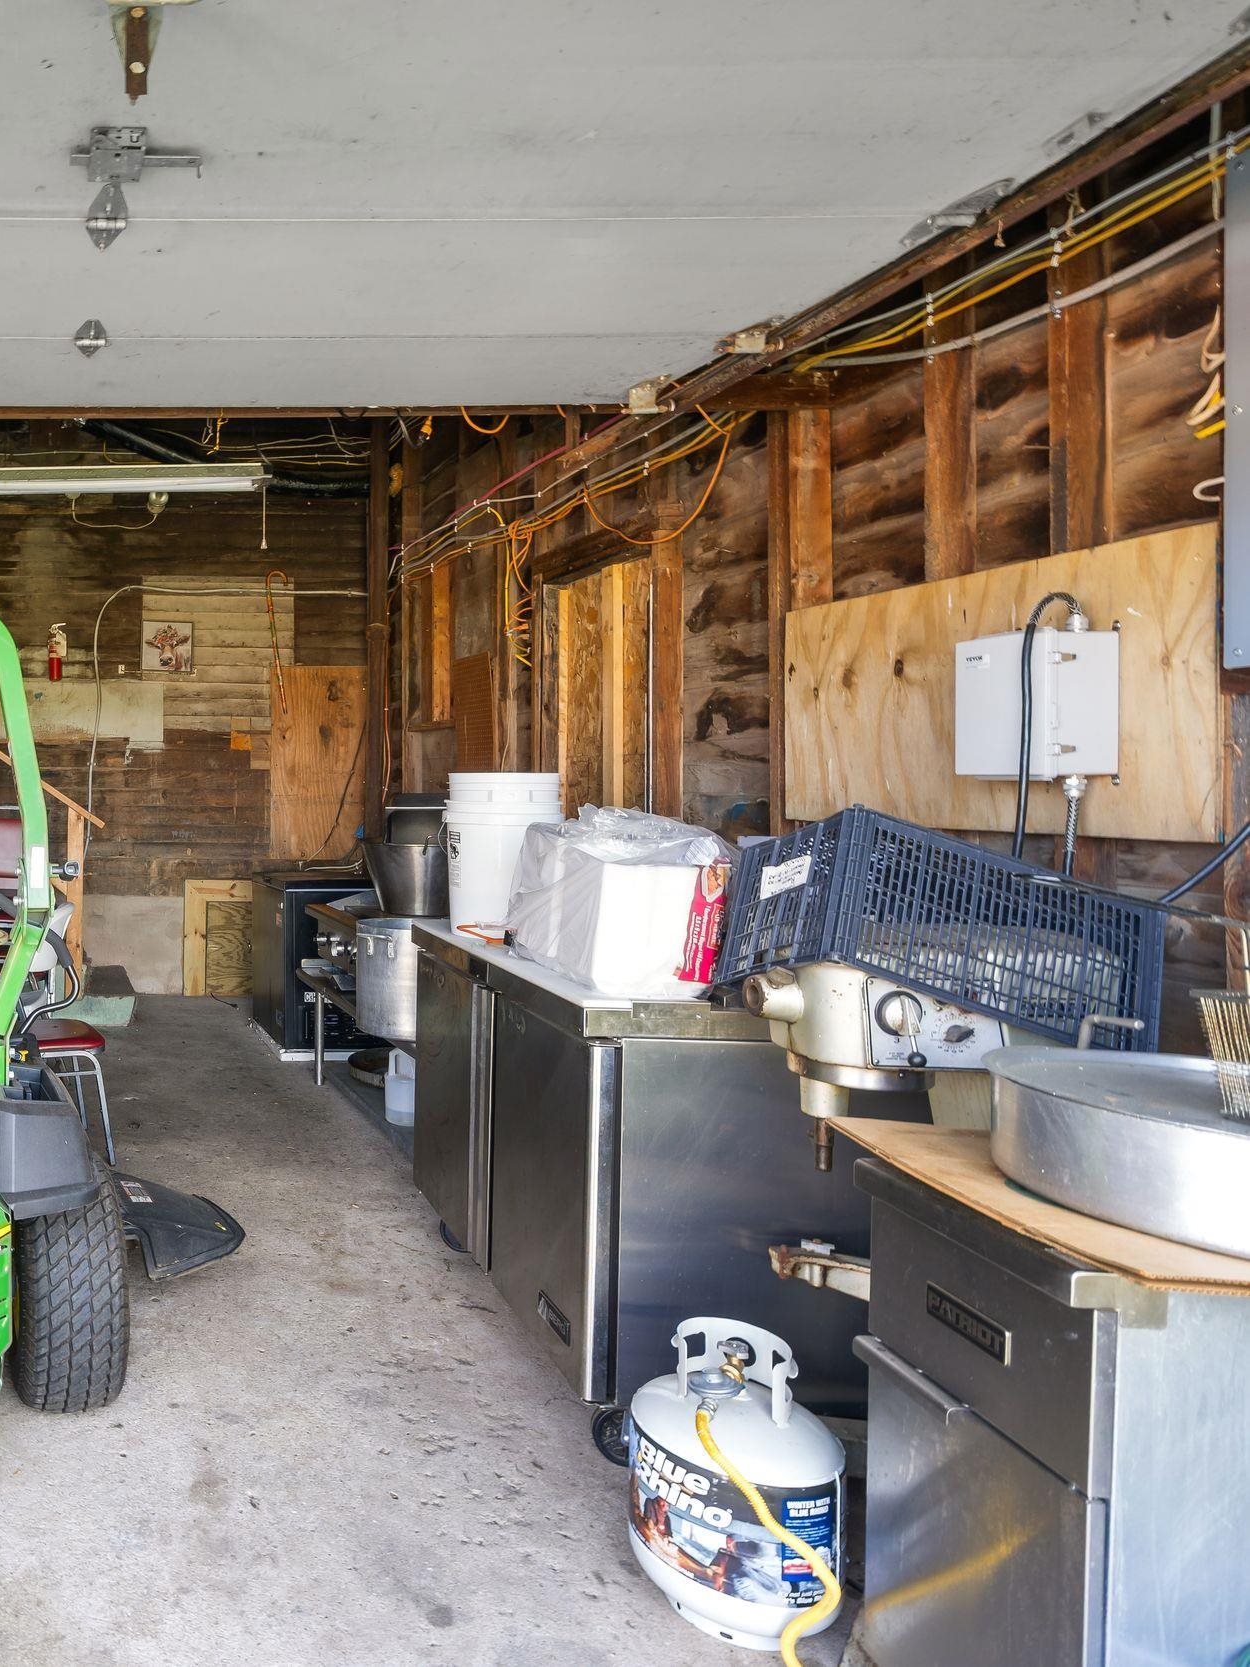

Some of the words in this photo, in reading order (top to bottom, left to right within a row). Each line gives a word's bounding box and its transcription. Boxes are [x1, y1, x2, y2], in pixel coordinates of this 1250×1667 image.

[928, 1289, 1004, 1353] PATRIOT
[637, 1460, 732, 1528] Rhino
[639, 1436, 710, 1496] Blue
